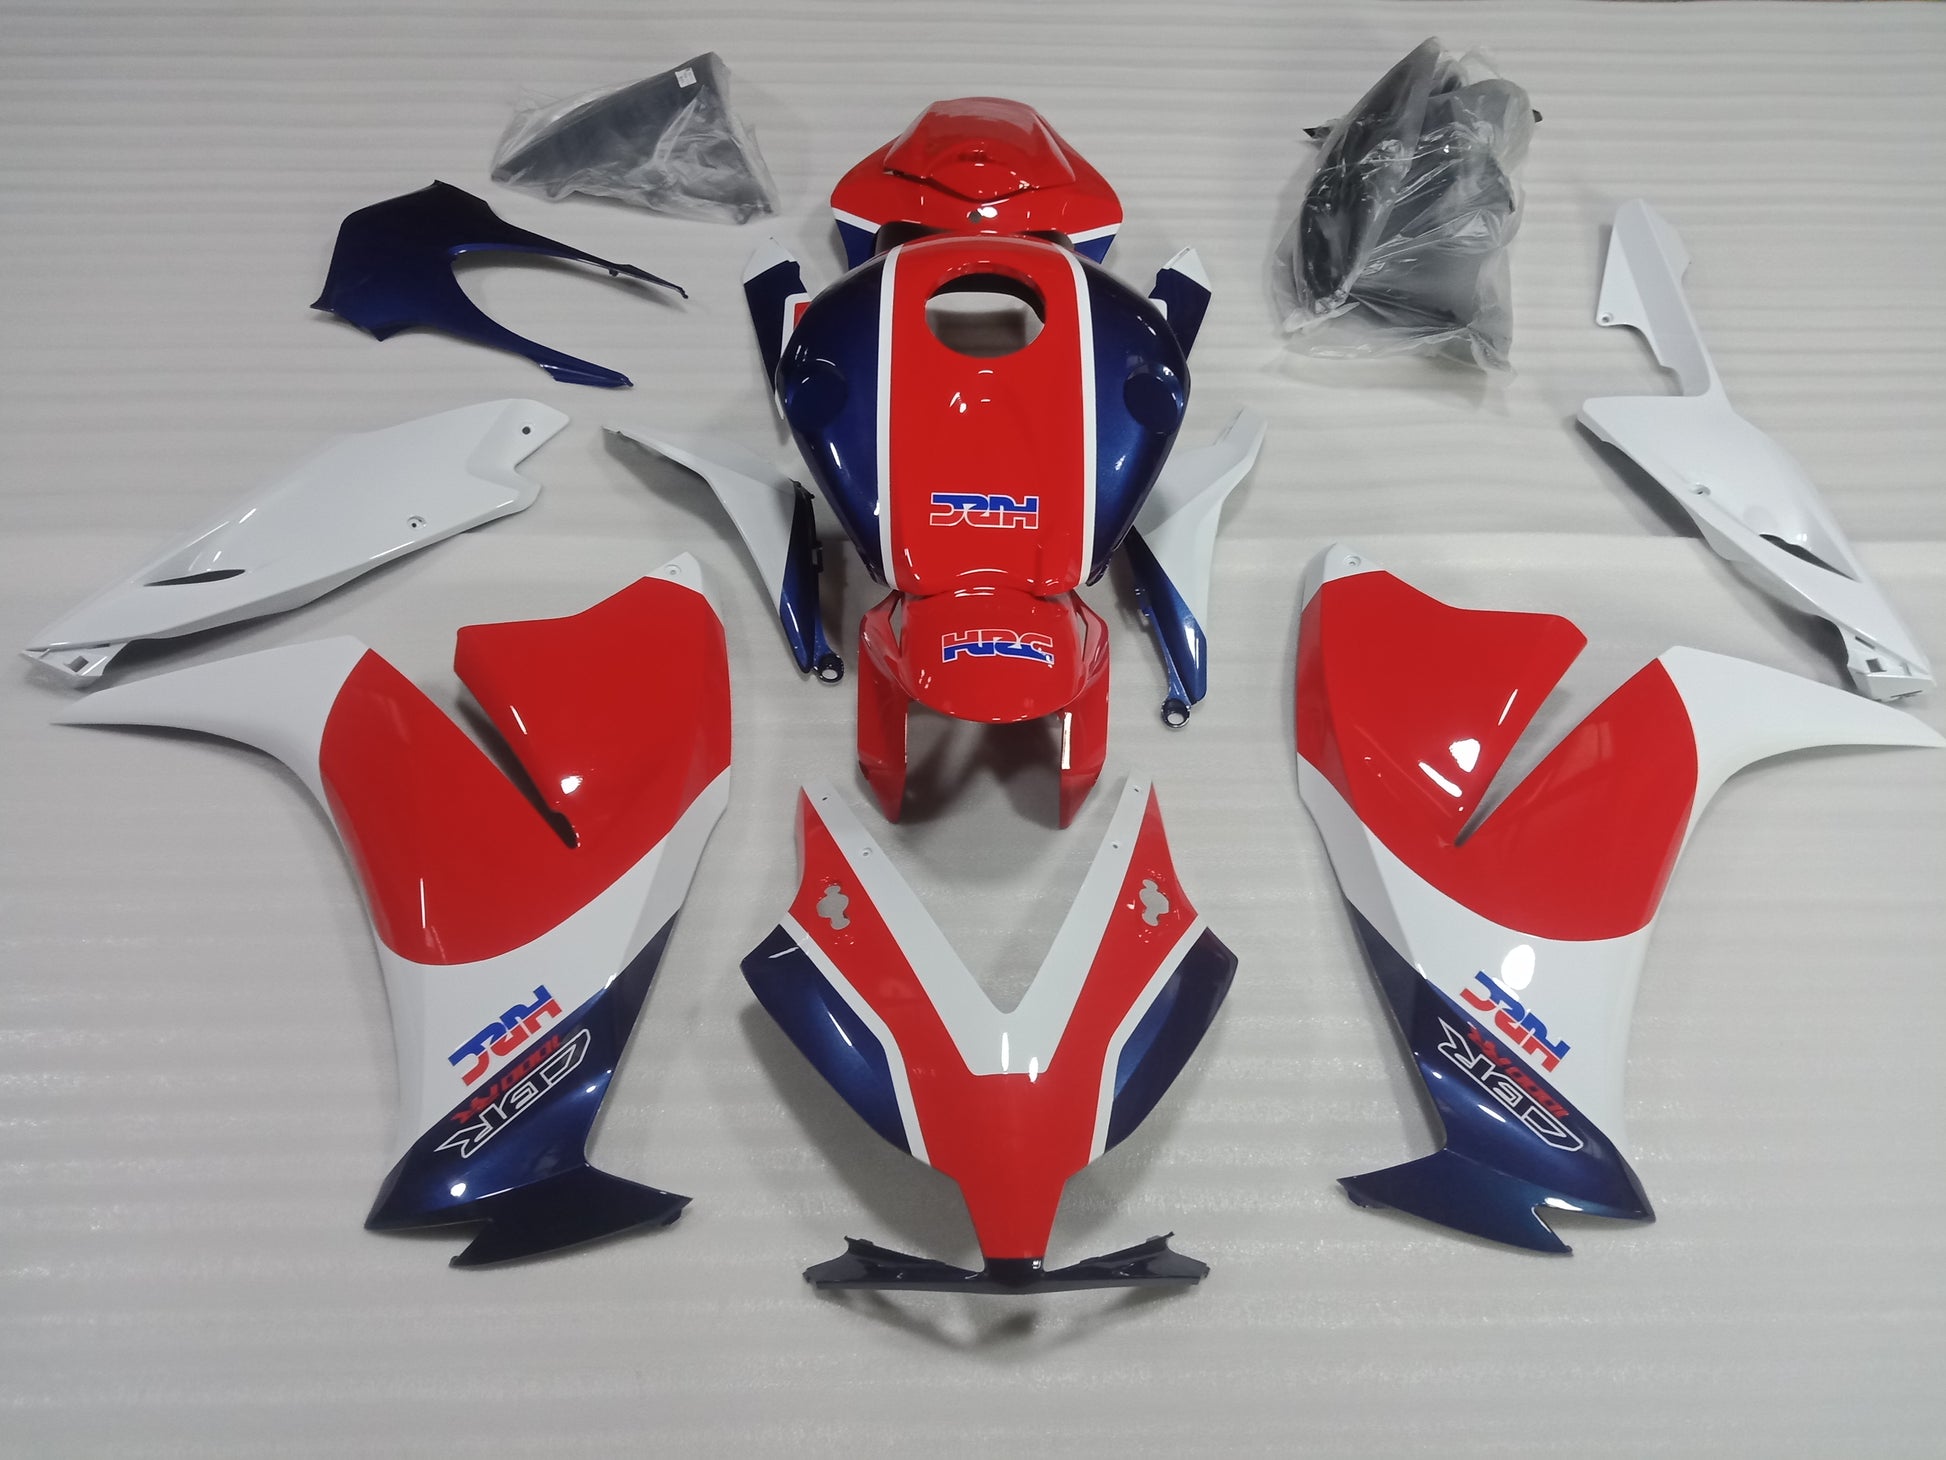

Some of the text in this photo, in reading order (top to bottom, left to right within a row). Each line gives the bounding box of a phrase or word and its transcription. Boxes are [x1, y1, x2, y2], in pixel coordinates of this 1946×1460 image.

[929, 492, 1040, 530] HRC
[941, 628, 1055, 666] HRC
[447, 984, 563, 1086] HRC
[1459, 970, 1571, 1073] HRC
[433, 1028, 592, 1159] CBR
[1437, 1016, 1584, 1152] CBR
